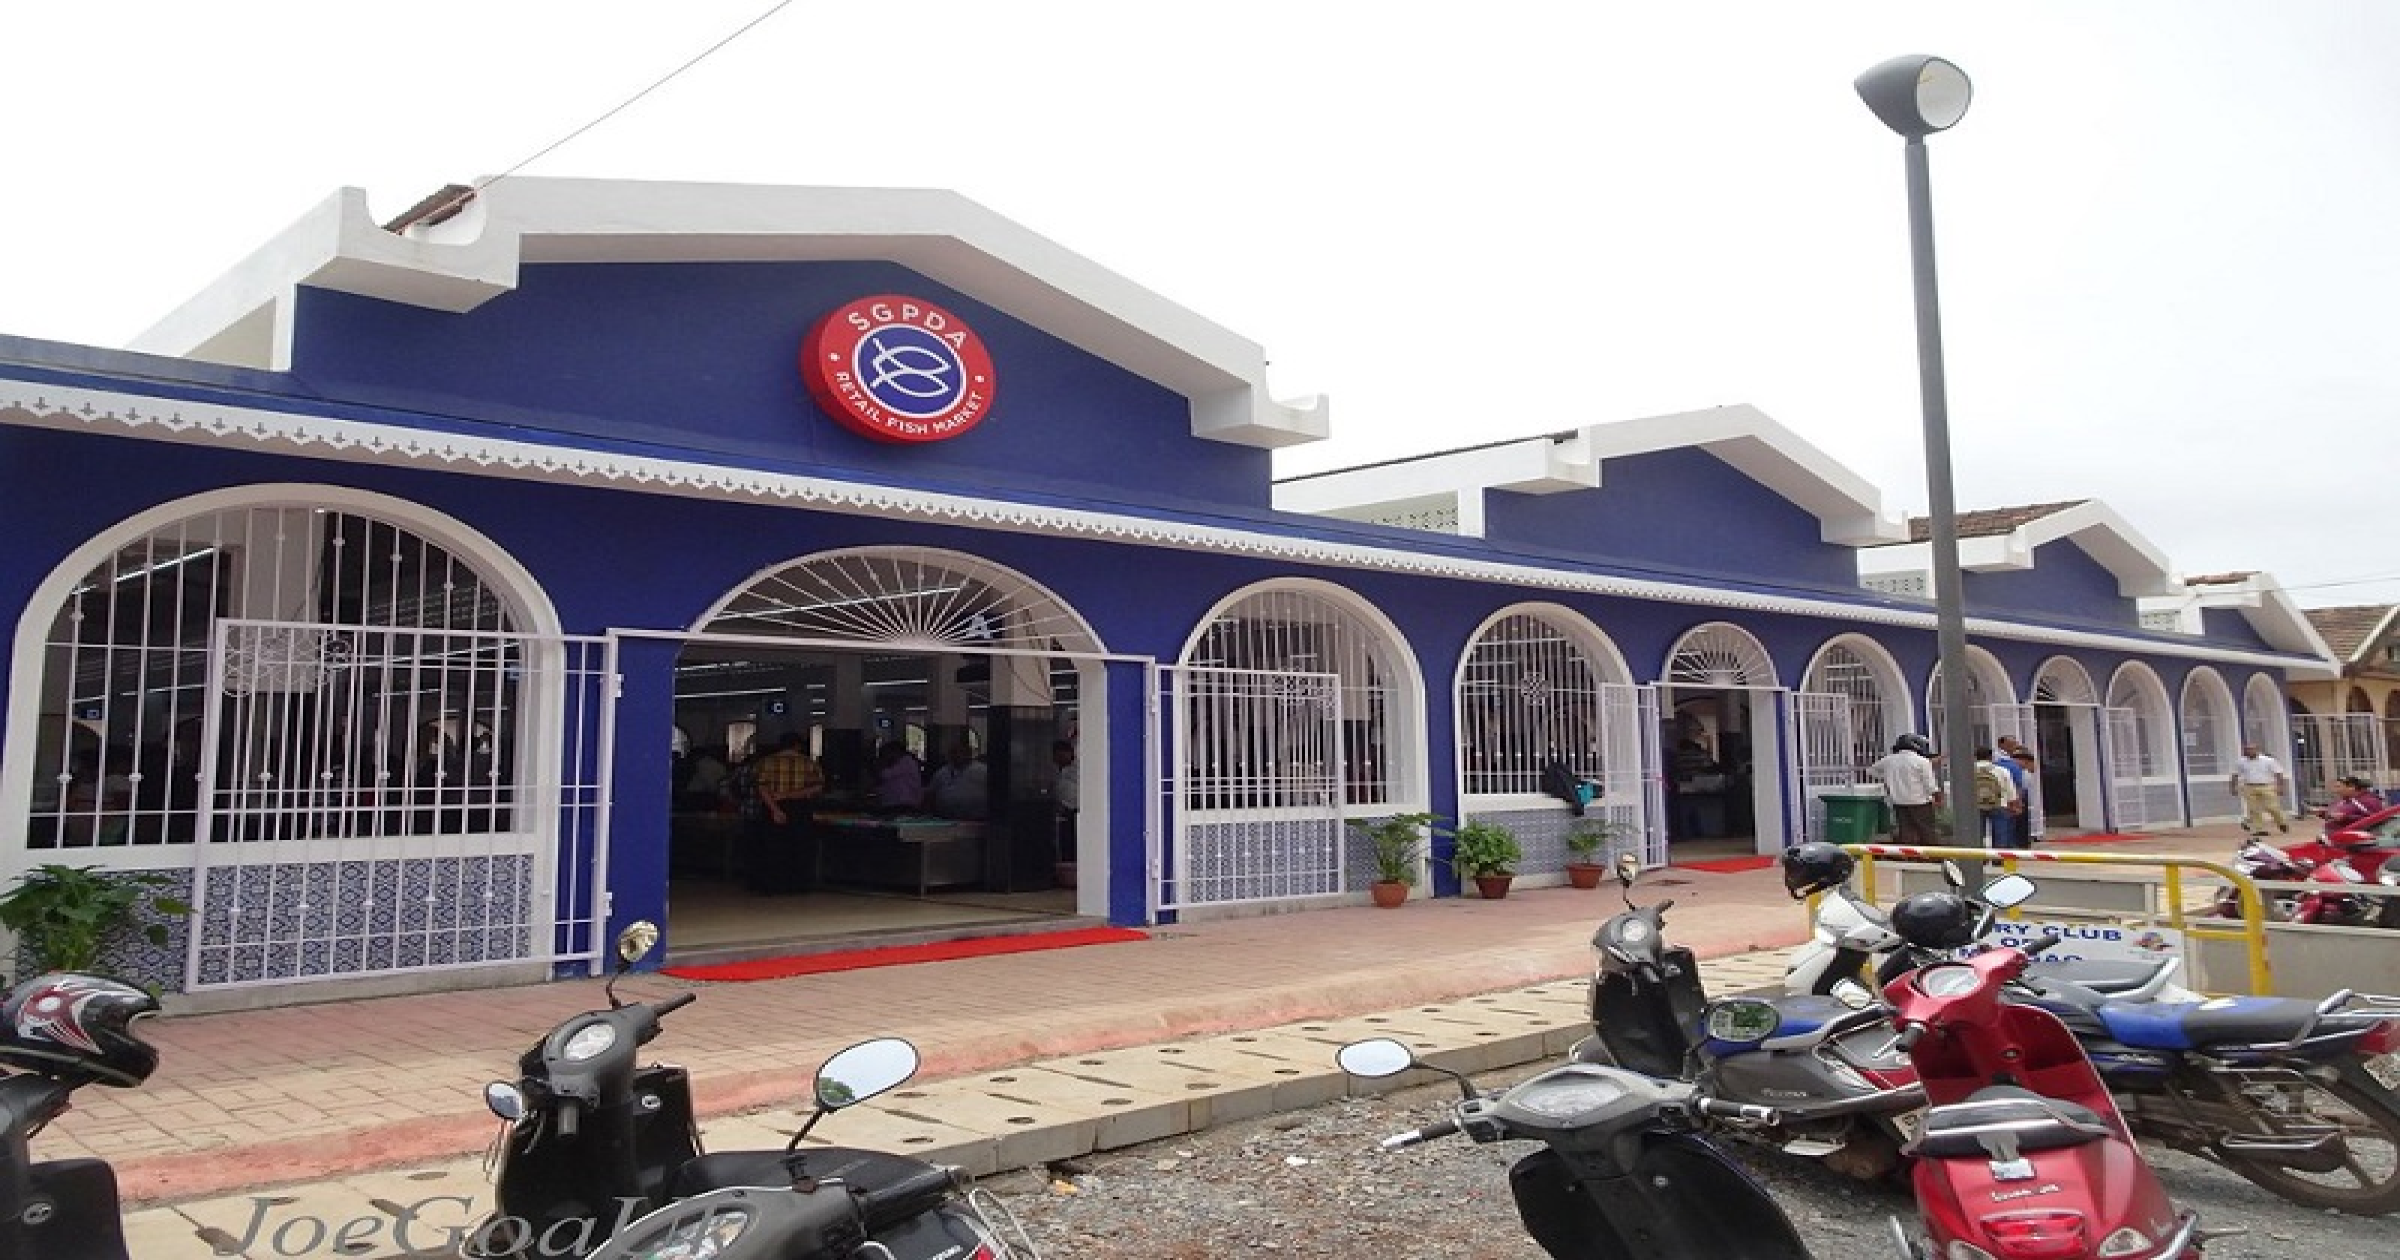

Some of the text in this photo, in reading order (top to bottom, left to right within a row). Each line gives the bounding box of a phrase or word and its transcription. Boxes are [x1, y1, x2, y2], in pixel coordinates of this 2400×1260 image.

[848, 303, 967, 348] SGPDA
[836, 371, 982, 434] RETAIL FISH MARKET
[2042, 925, 2122, 941] CLUB
